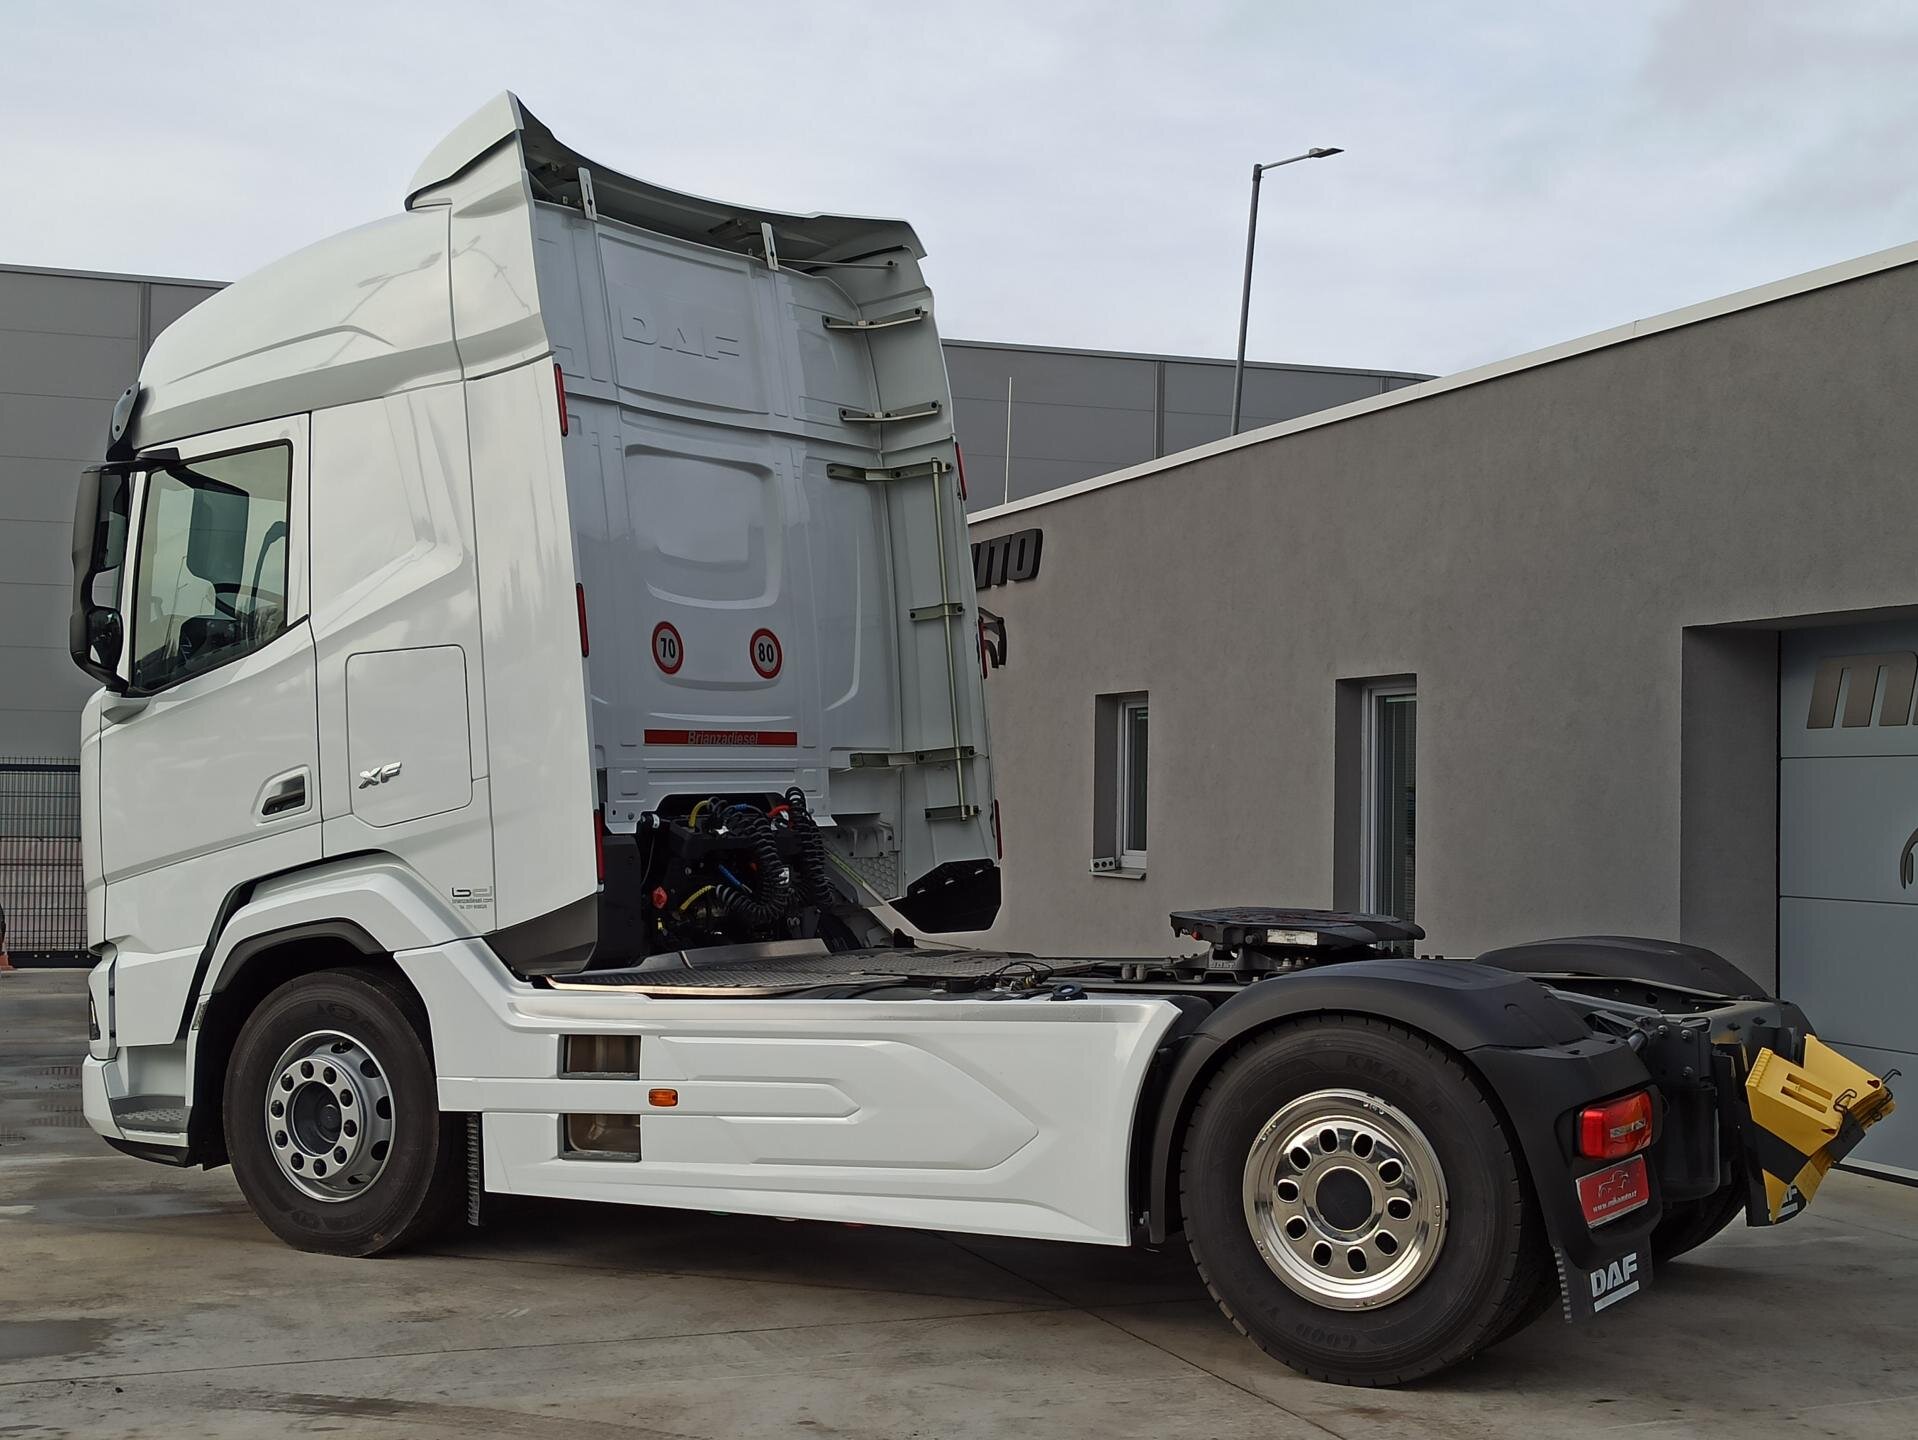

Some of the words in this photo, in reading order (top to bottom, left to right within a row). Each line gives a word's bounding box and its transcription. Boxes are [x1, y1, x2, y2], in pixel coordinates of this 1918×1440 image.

[660, 637, 676, 659] 70
[758, 642, 774, 663] 80
[687, 731, 759, 745] Brianzadiesel
[359, 762, 402, 789] XF
[1590, 1252, 1638, 1298] DAF
